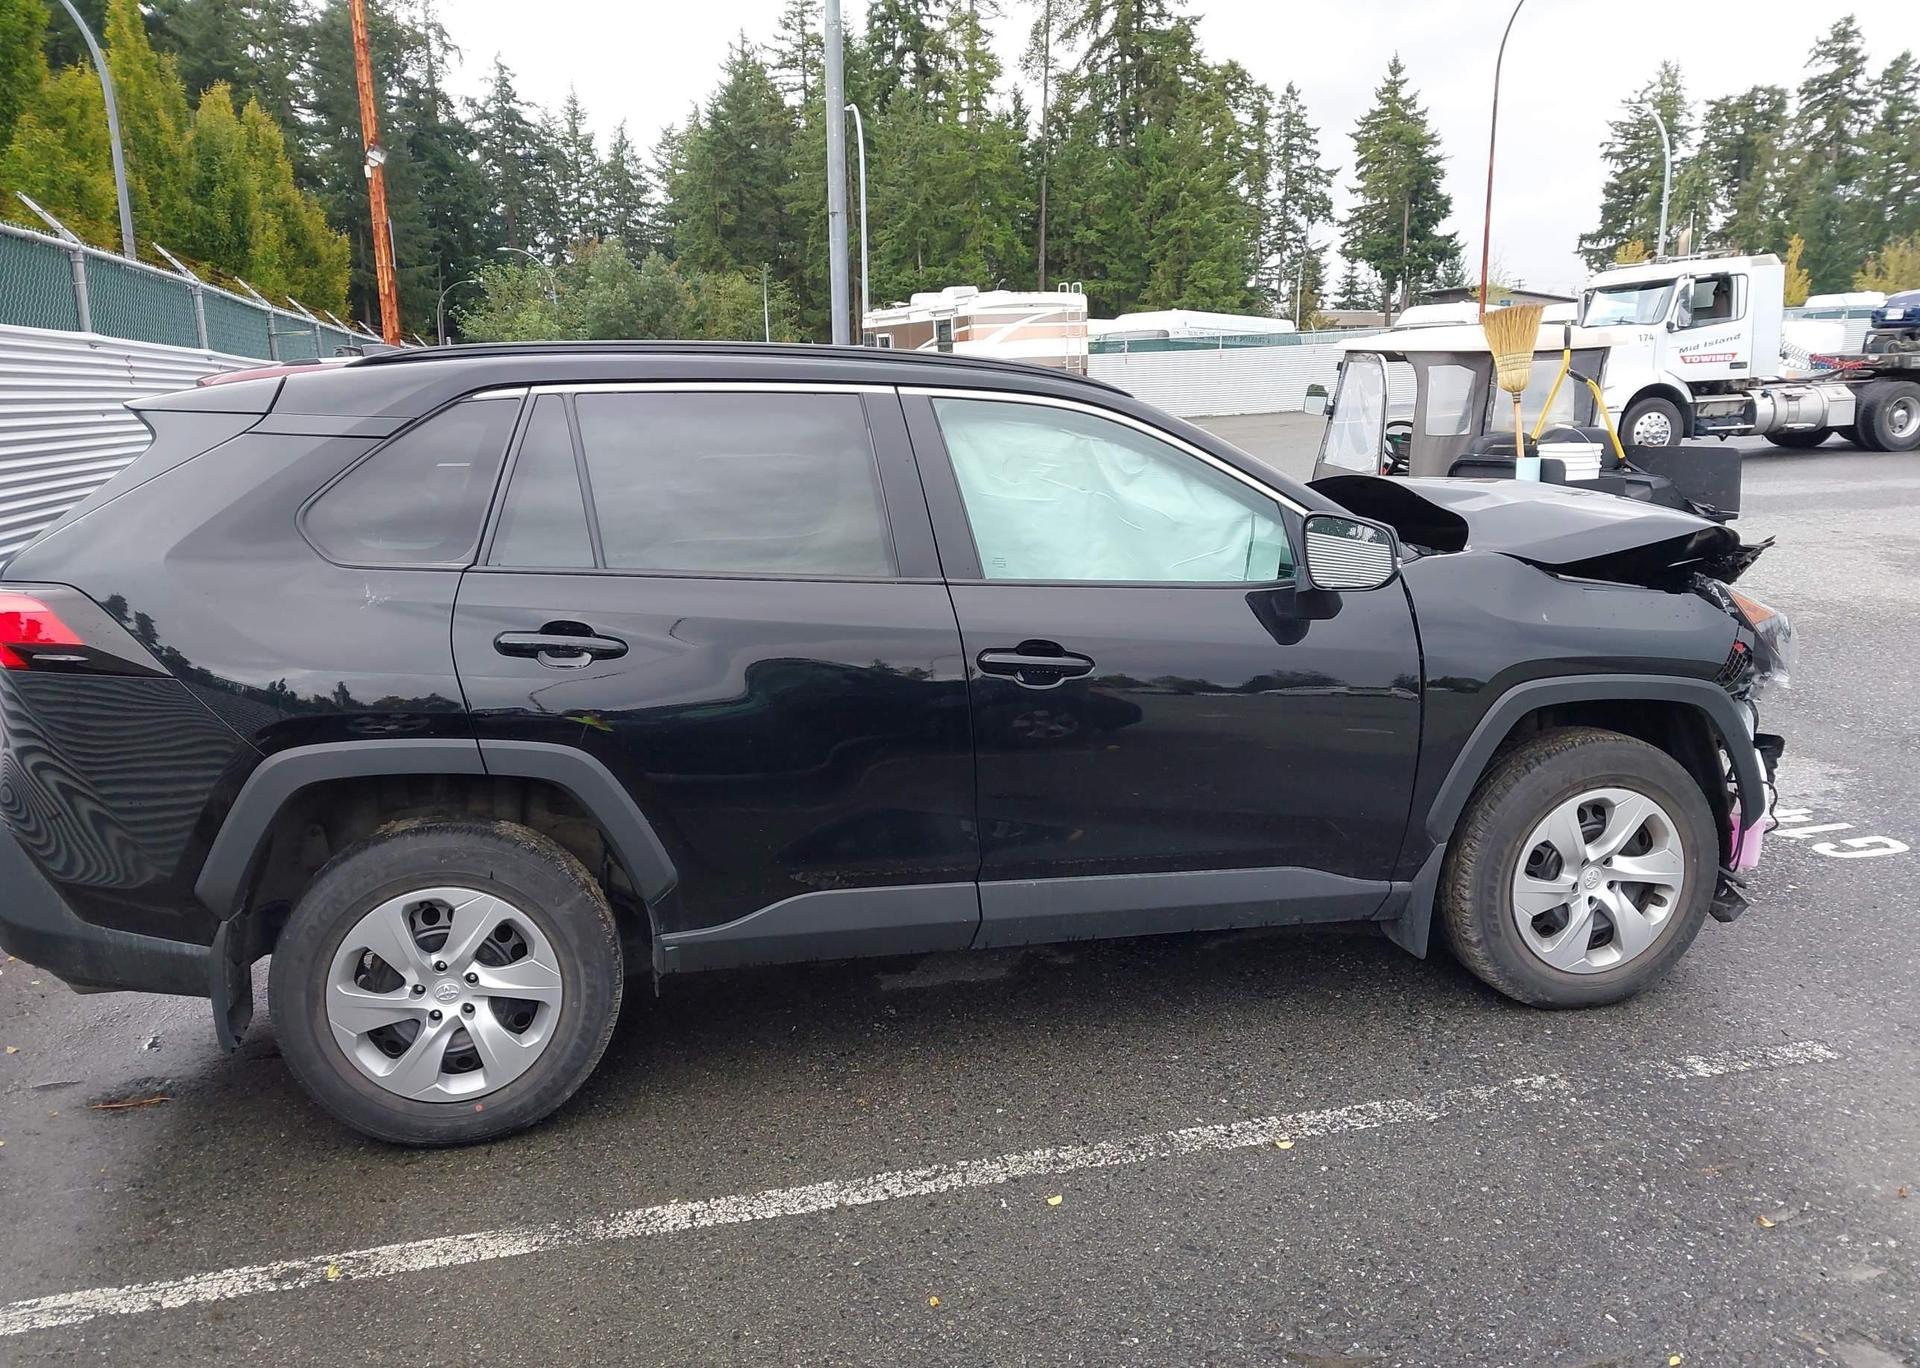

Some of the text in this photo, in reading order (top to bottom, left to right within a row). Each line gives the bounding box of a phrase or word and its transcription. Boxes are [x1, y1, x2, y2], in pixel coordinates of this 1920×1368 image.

[1638, 333, 1655, 342] 174
[1679, 332, 1741, 354] Mid Island
[1684, 353, 1734, 364] TOWING
